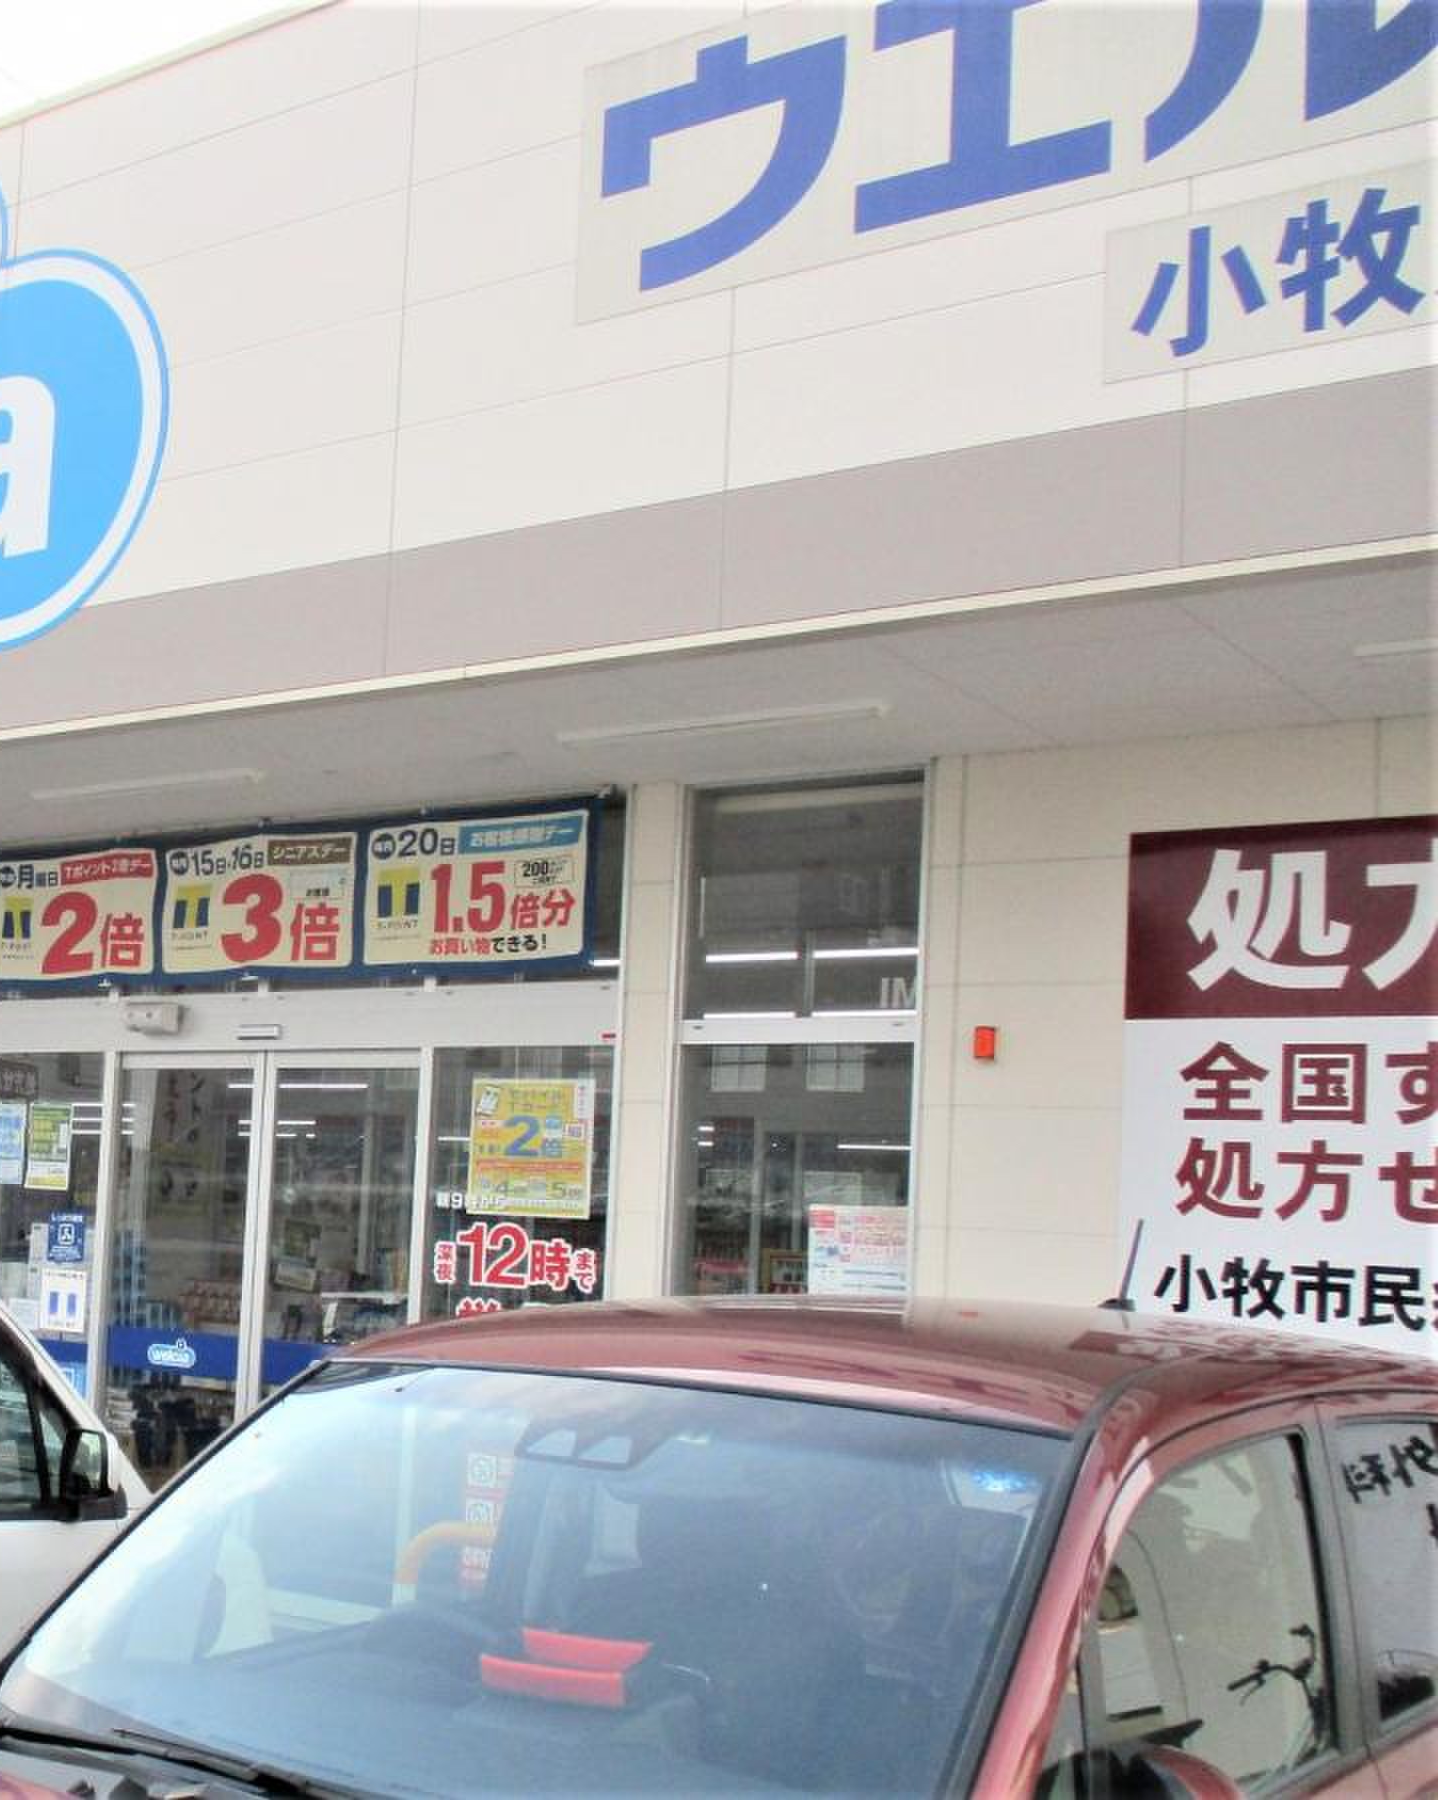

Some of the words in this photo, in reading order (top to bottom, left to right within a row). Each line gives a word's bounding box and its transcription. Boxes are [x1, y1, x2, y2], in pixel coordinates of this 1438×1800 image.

[1132, 188, 1438, 357] 小牧
[41, 891, 145, 975] 2倍
[220, 873, 341, 962] 3倍
[1175, 1137, 1438, 1225] 処方せ
[457, 1222, 571, 1291] 12時
[1154, 1253, 1438, 1332] 小牧市民
